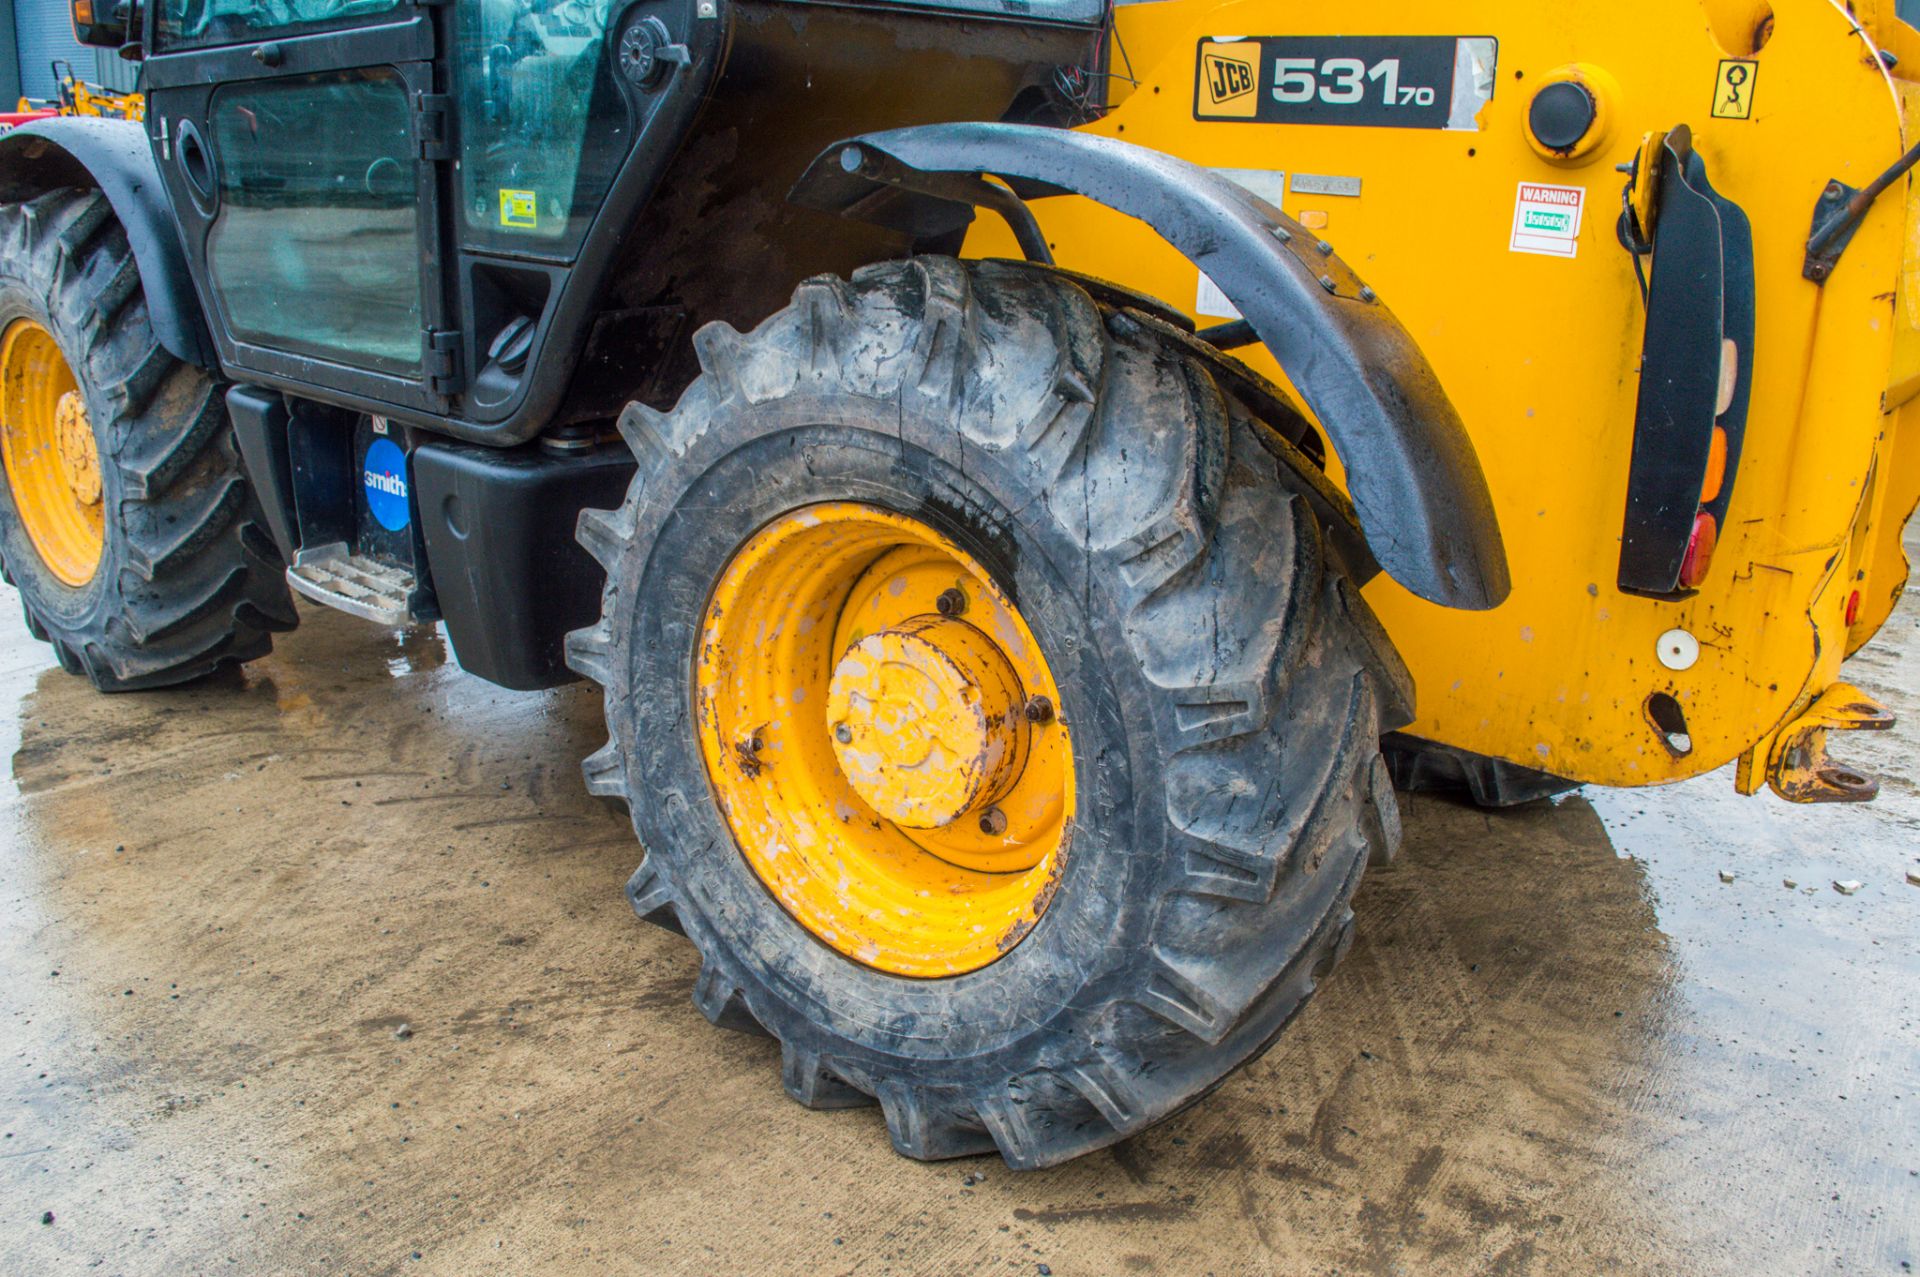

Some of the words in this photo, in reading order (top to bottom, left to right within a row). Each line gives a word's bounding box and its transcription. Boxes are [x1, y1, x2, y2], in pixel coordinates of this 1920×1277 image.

[1212, 59, 1252, 99] JCB
[1272, 58, 1400, 106] 531
[1398, 86, 1435, 106] 70
[1522, 187, 1578, 205] WARNING
